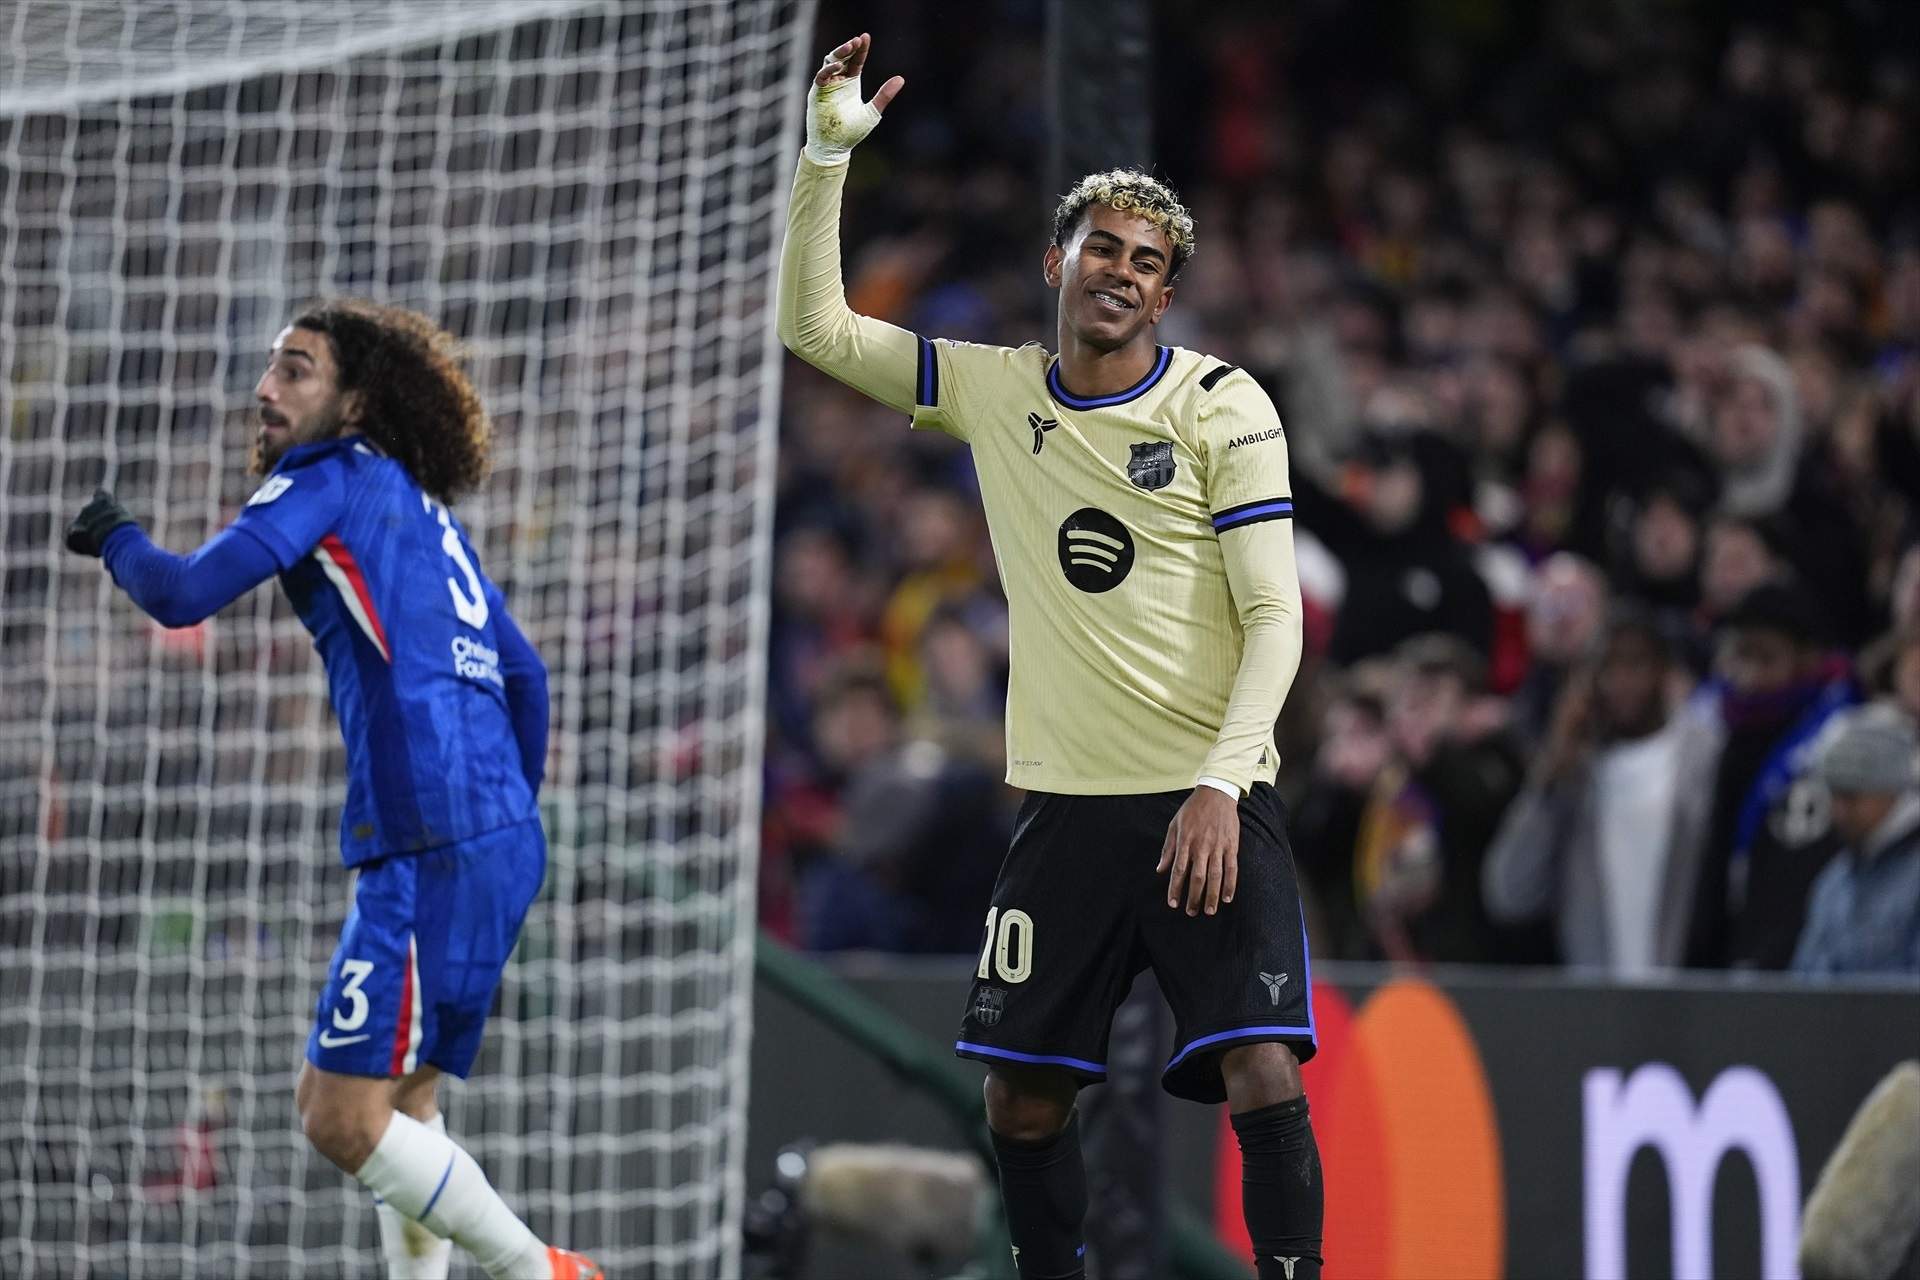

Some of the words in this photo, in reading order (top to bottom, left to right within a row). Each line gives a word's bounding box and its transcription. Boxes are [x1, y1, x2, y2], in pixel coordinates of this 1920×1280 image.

[421, 491, 489, 630] 3
[977, 906, 1034, 984] 10
[333, 958, 374, 1031] 3
